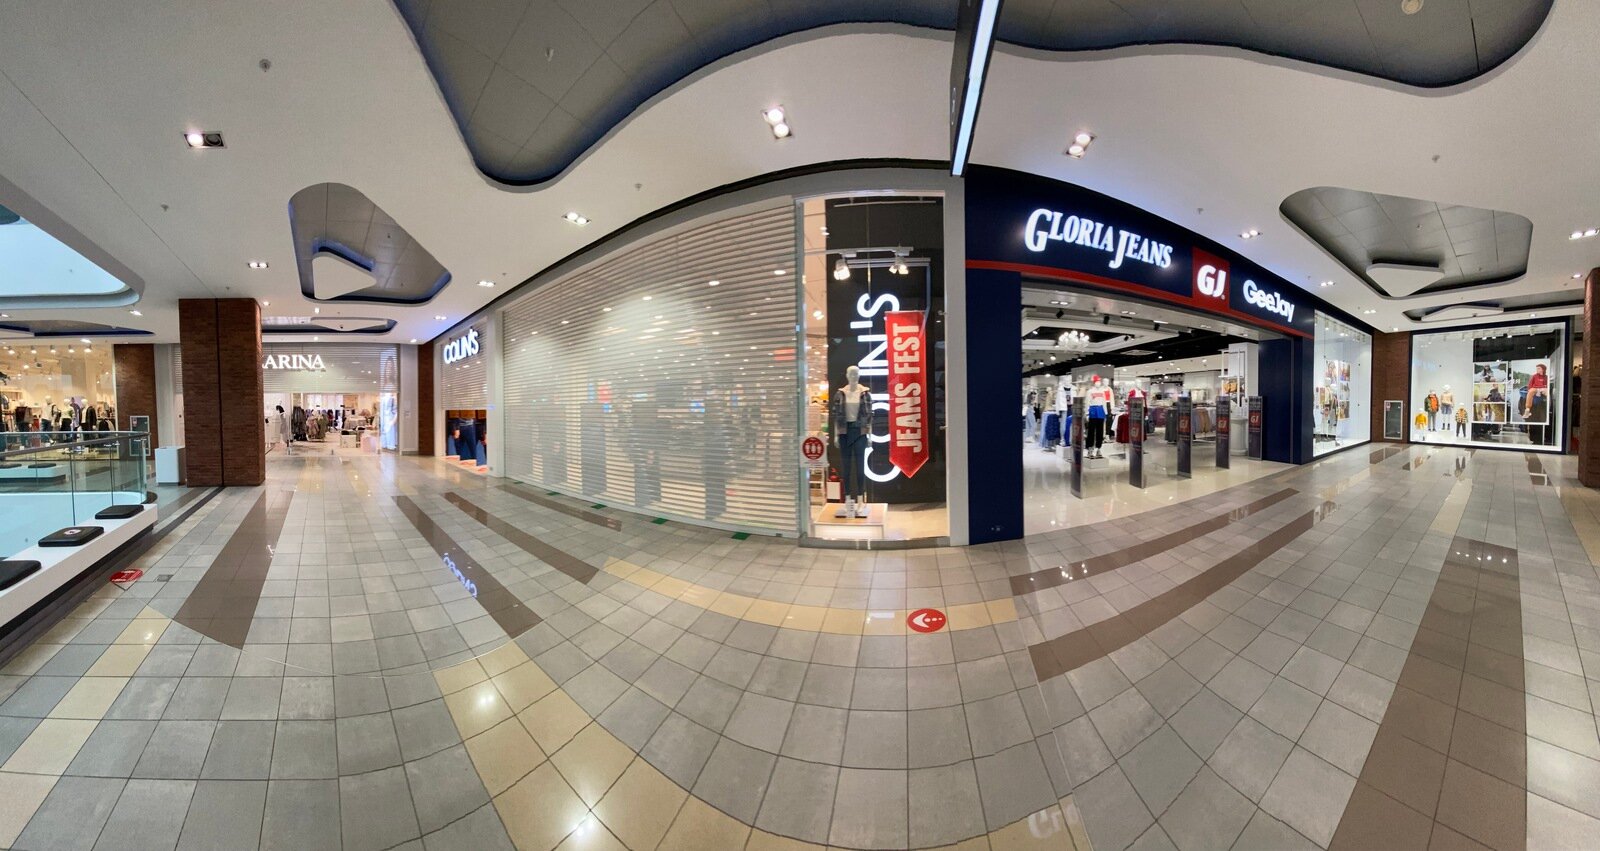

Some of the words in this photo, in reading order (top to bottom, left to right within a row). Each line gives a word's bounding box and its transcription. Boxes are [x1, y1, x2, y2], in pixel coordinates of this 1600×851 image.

[1024, 208, 1114, 252] GLORIA
[1108, 229, 1173, 269] JEANS
[1243, 279, 1295, 323] GeeJay
[261, 354, 326, 369] ARINA
[443, 328, 480, 364] COLIN'S
[892, 323, 921, 374] FEST
[894, 382, 922, 453] JEANS
